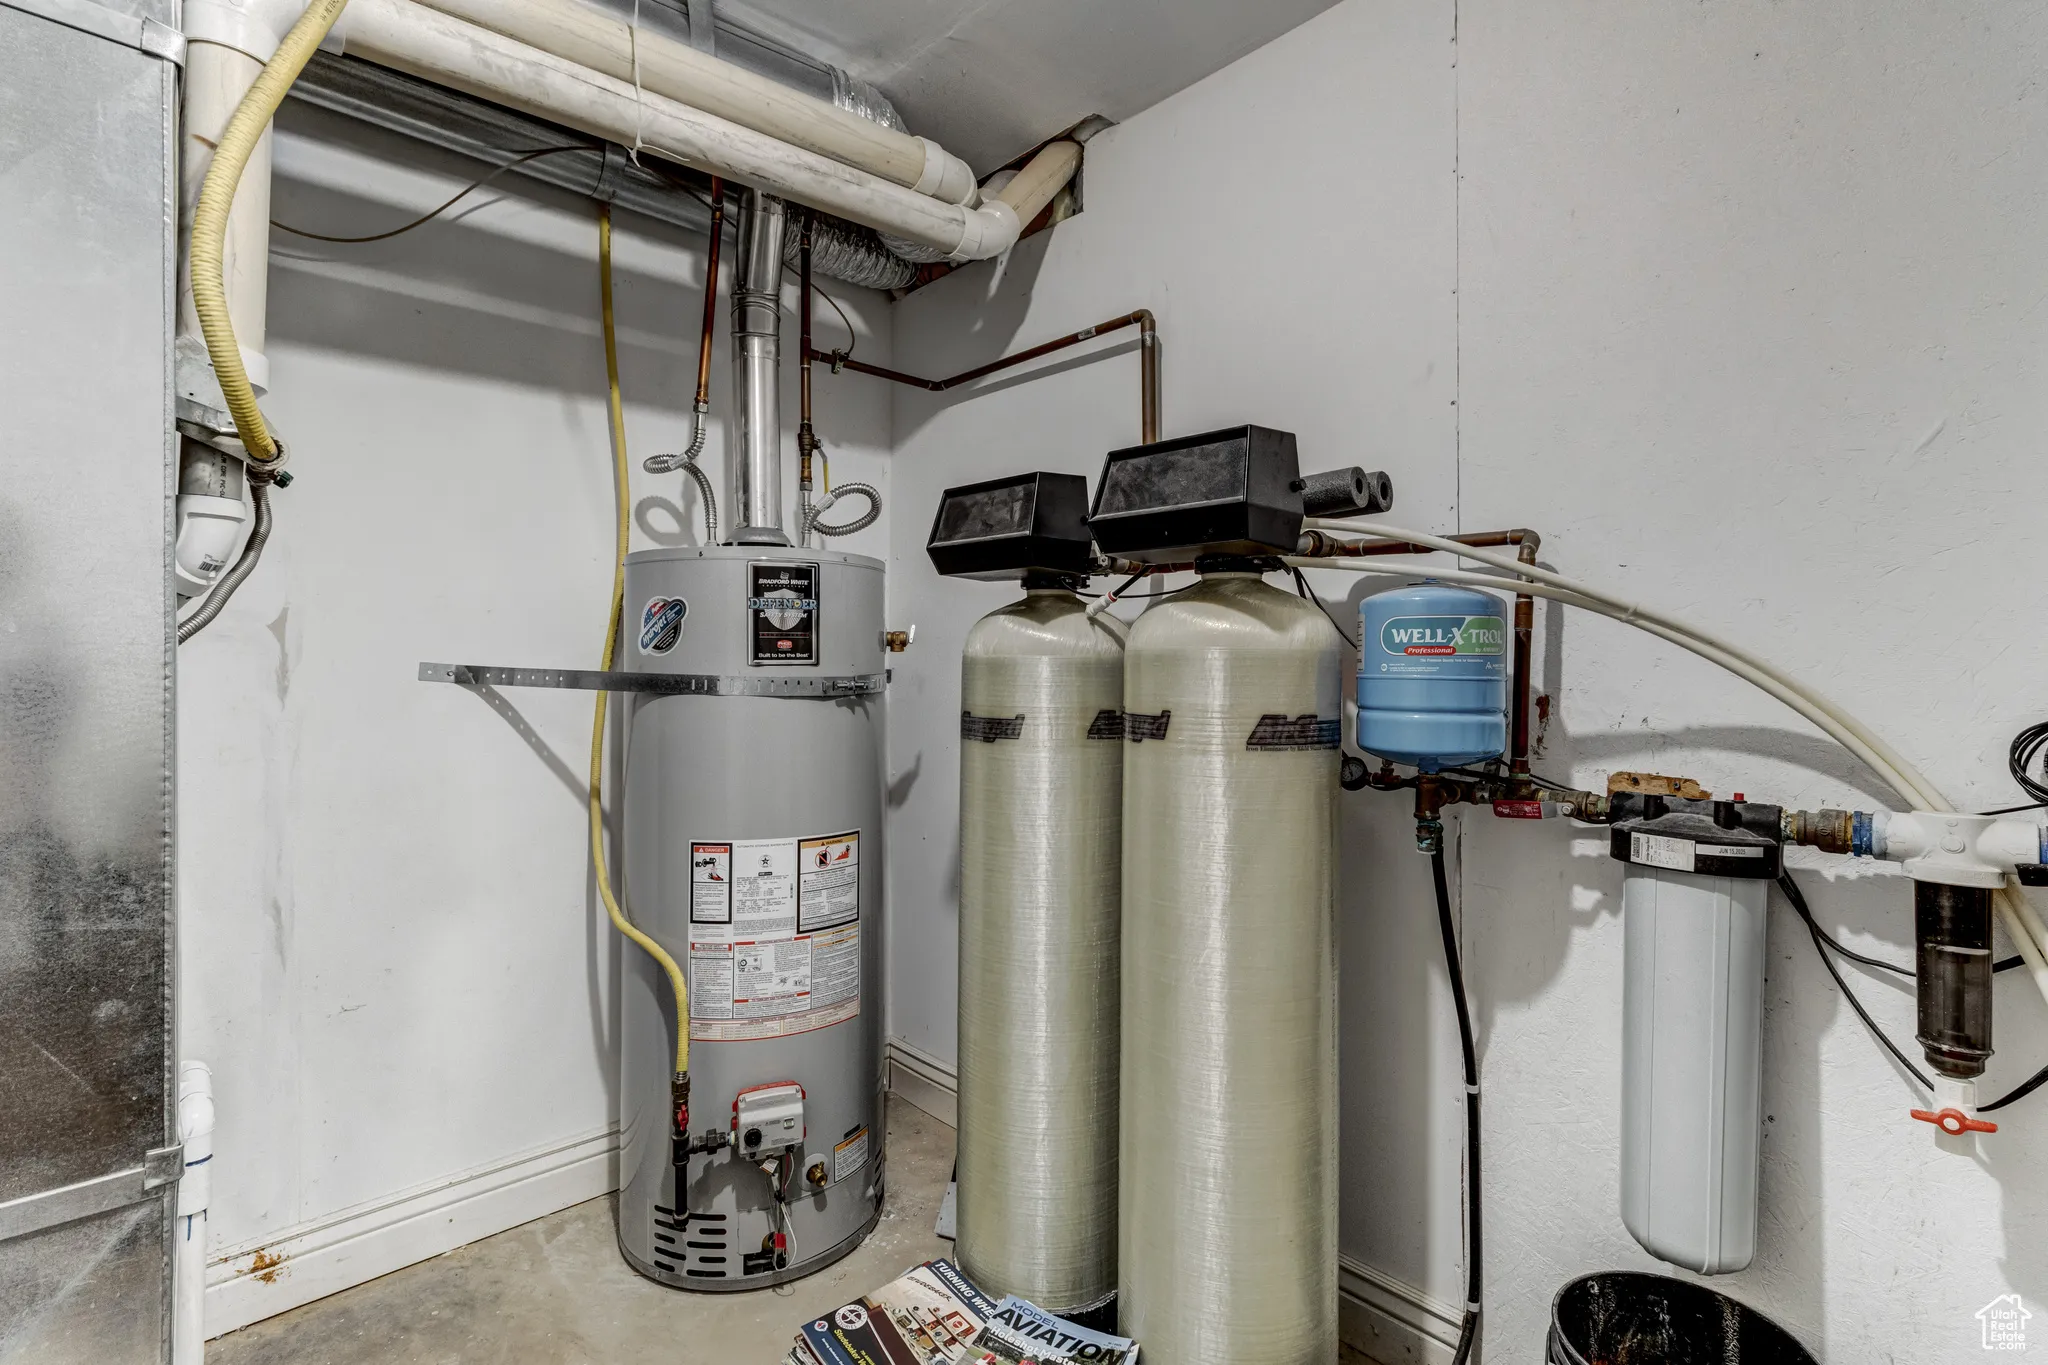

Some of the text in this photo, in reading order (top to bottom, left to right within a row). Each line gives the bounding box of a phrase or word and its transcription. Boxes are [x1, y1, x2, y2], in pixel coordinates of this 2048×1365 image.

[749, 598, 818, 610] DEFENDER
[642, 613, 667, 646] Hydrojet
[1391, 626, 1503, 646] WELL-X-TROL
[935, 1262, 975, 1297] TURNING
[971, 1297, 996, 1318] WHE
[1010, 1302, 1060, 1330] MODEL
[834, 1328, 861, 1360] Studebaker
[990, 1326, 1039, 1353] Holeshot
[992, 1308, 1127, 1365] AVIATION
